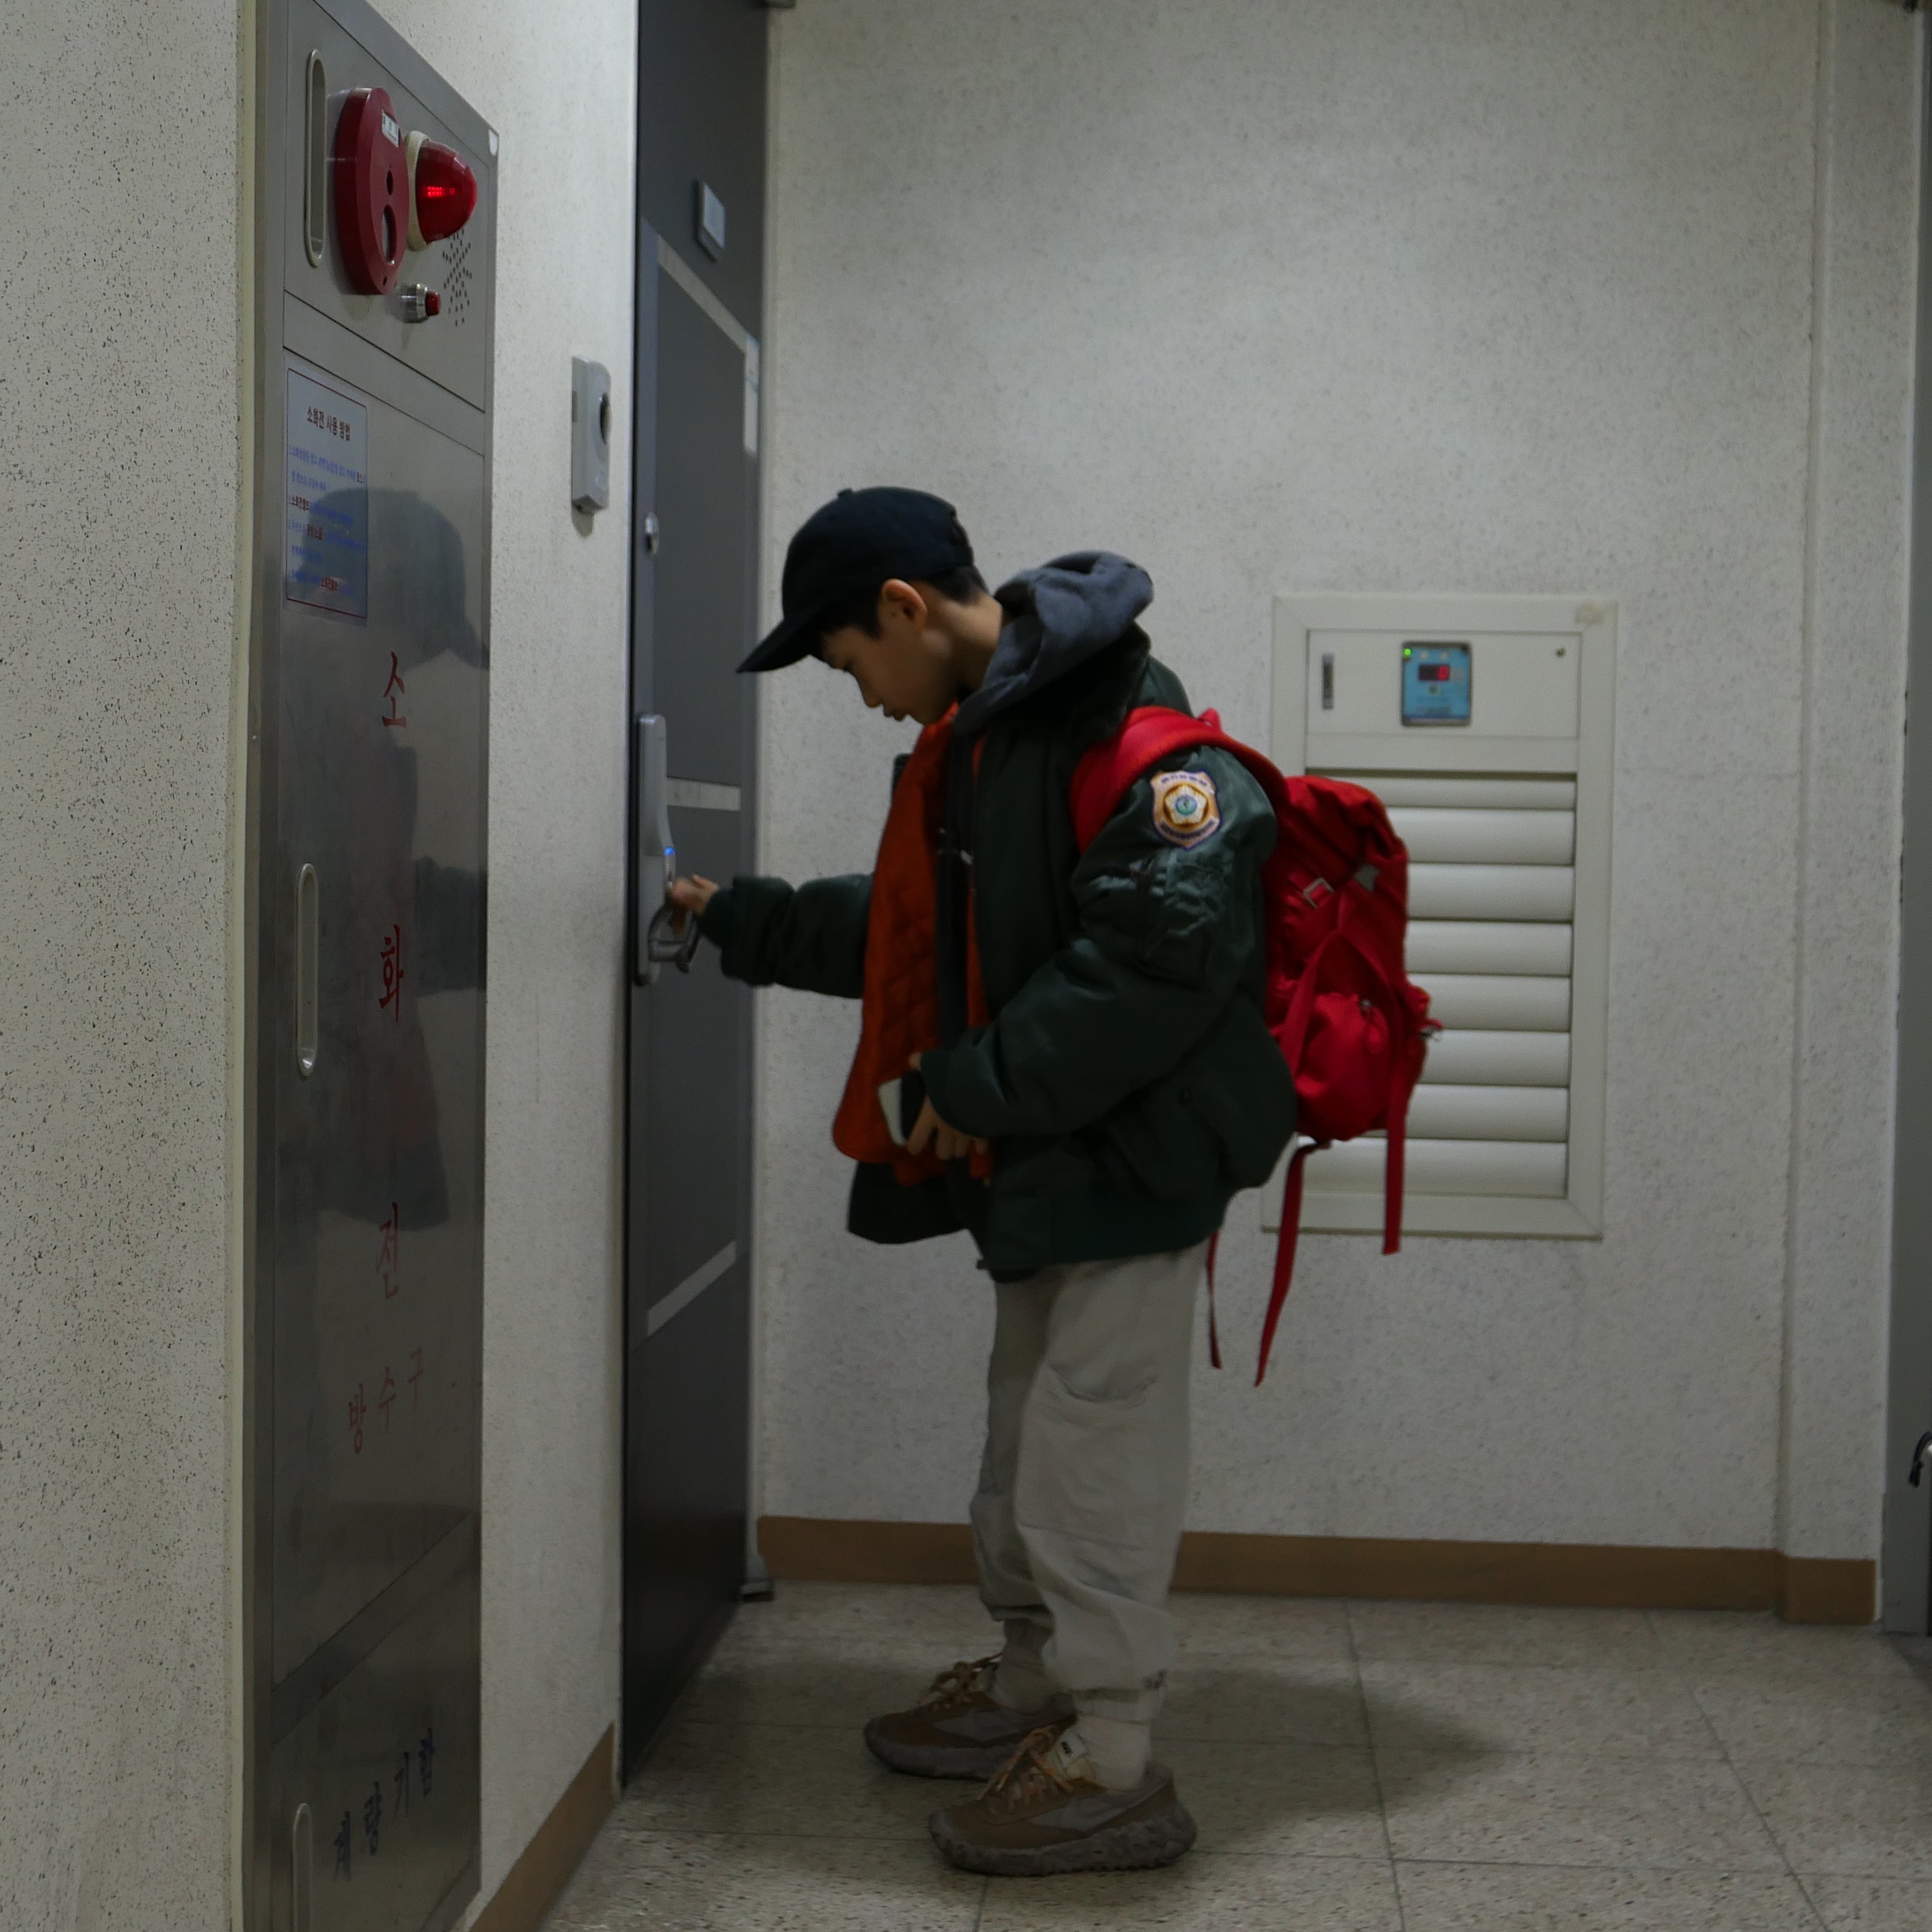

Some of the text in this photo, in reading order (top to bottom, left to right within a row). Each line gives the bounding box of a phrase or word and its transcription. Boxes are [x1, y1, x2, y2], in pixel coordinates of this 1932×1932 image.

[307, 405, 351, 441] 소화전 사용 방법
[348, 1346, 424, 1454] 방수구
